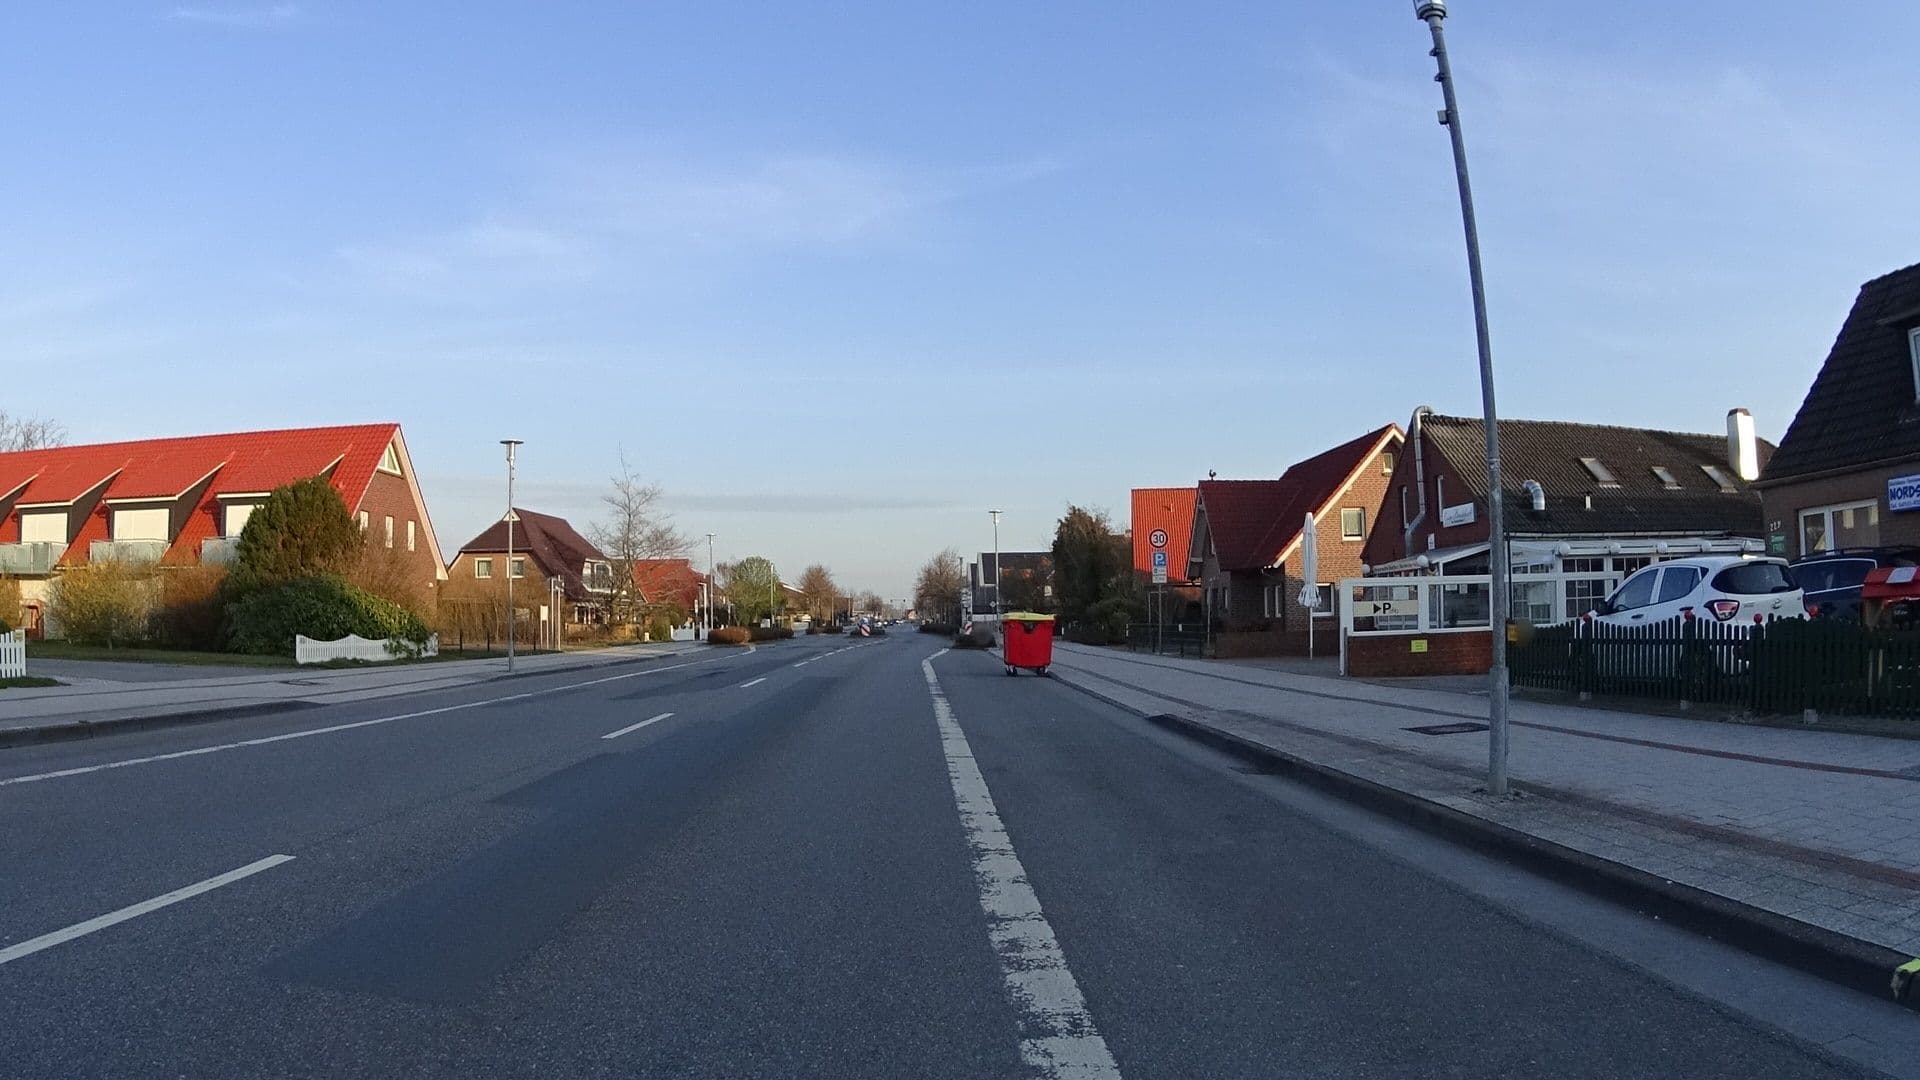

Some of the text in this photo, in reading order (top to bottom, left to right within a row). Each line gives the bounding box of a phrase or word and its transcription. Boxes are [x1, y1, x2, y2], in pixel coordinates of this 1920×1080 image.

[1890, 484, 1920, 500] NORDS
[1153, 534, 1165, 544] 30
[1155, 553, 1164, 566] P
[1382, 602, 1392, 614] P
